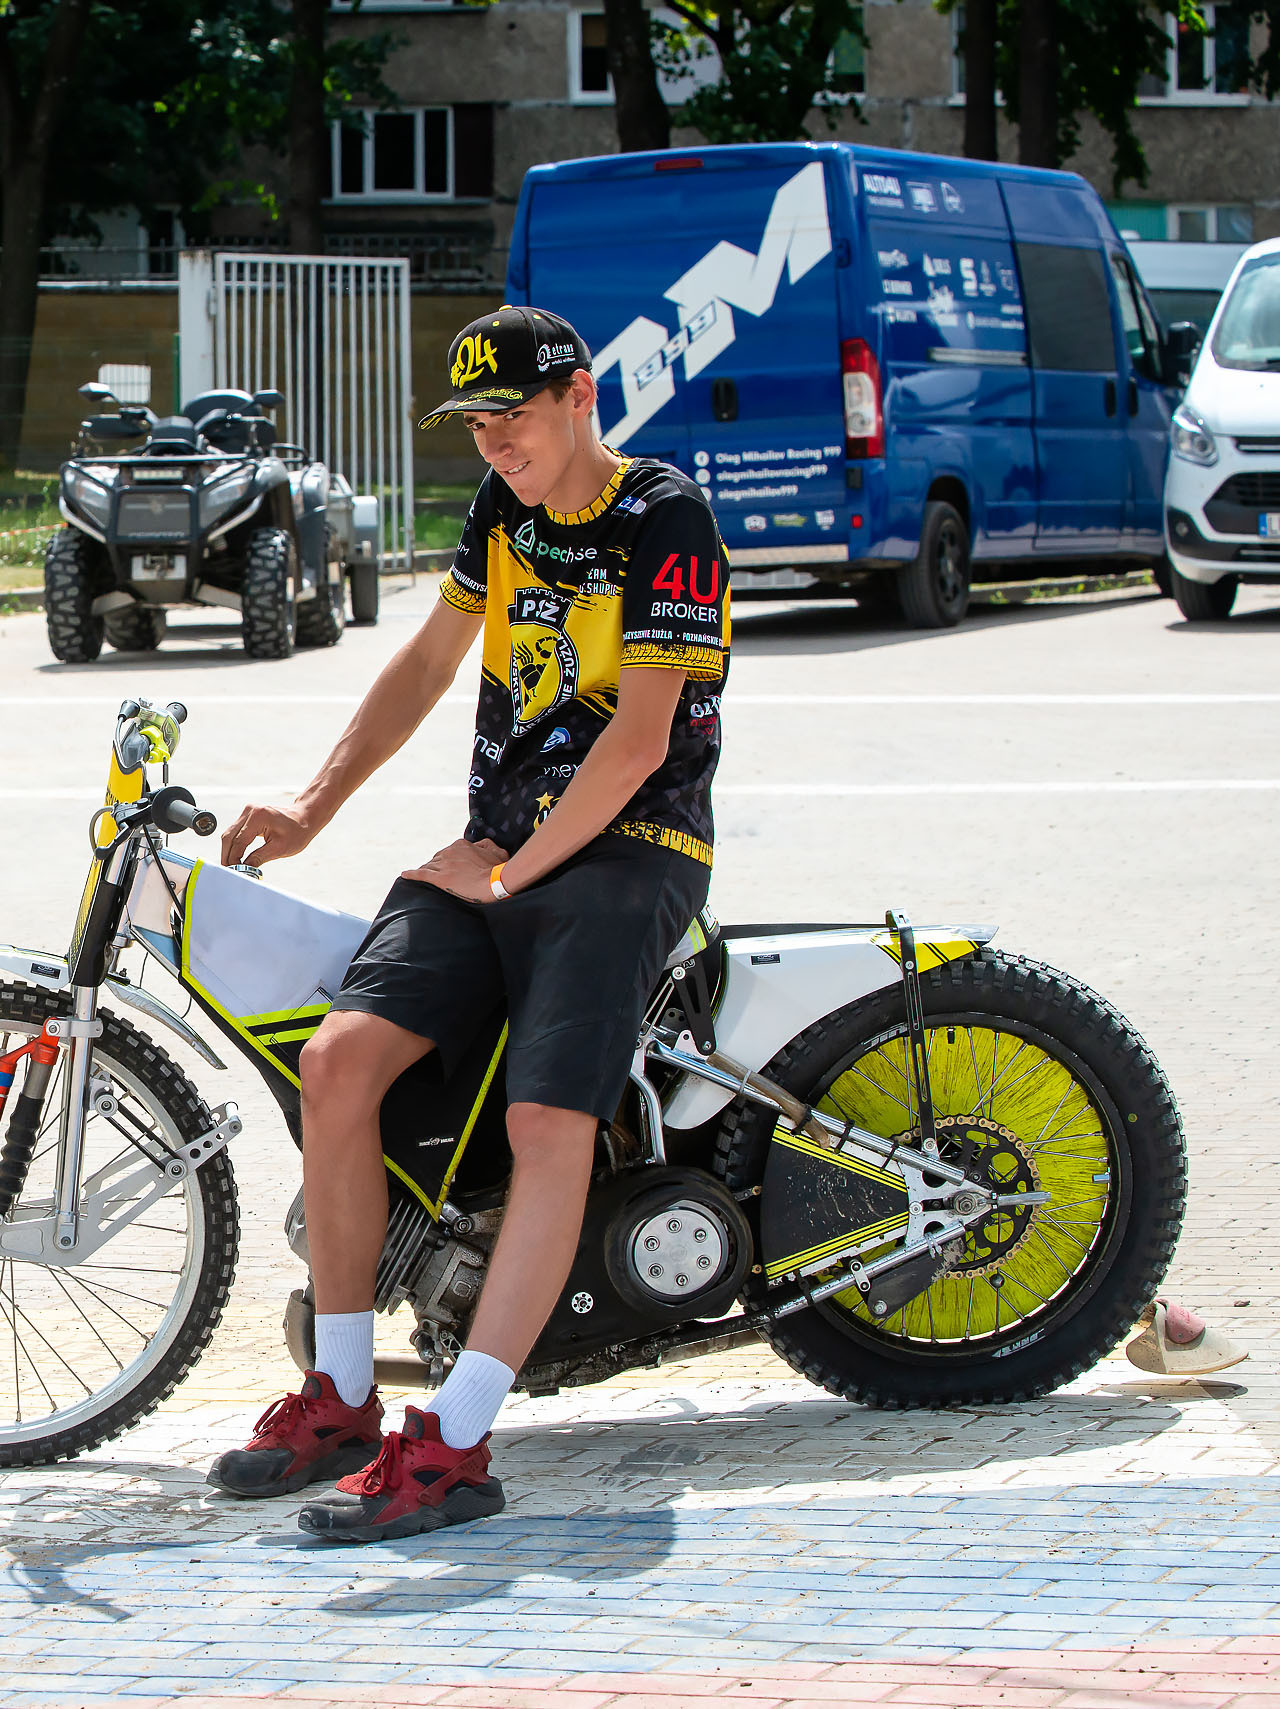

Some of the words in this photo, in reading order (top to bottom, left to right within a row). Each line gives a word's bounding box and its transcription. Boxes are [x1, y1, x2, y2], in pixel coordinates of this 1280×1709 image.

[451, 333, 498, 389] #24
[715, 453, 741, 465] Oleg
[742, 450, 785, 463] Mihailov
[786, 448, 822, 461] Racing
[823, 445, 841, 457] 999
[716, 464, 828, 483] olegmihailovracing999
[717, 484, 799, 502] olegmihailov999
[652, 553, 719, 604] 4U
[650, 601, 718, 624] BROKER
